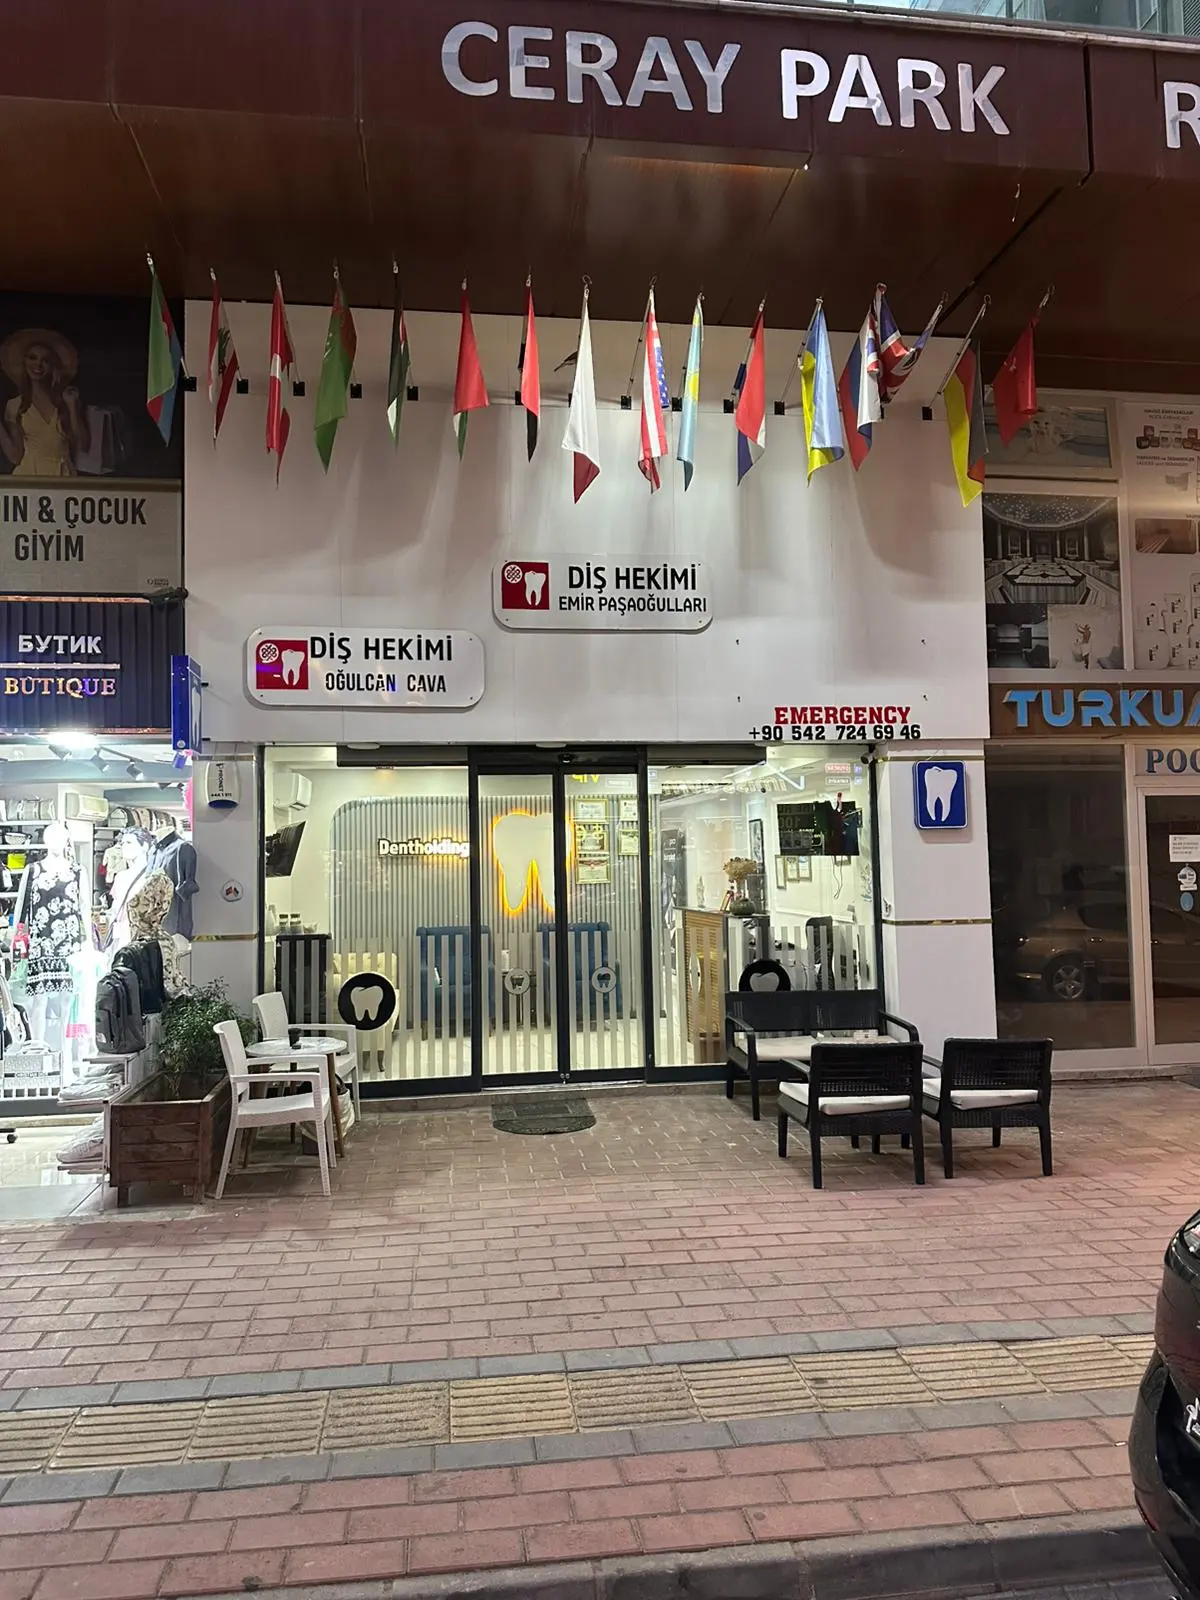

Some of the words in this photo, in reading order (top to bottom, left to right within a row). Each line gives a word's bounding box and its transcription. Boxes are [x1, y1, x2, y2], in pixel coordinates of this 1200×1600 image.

[441, 21, 741, 113] CERAY
[780, 48, 1010, 135] PARK
[38, 496, 56, 523] &
[65, 496, 147, 529] ÇOCUK
[14, 528, 84, 562] GİYİM
[568, 562, 607, 593] DİŞ
[615, 563, 696, 591] HEKİMİ
[558, 592, 595, 611] EMİR
[599, 593, 707, 616] PAŞAOĞULLARI
[18, 634, 102, 654] БУТИК
[310, 632, 352, 664] DİŞ
[364, 635, 452, 661] HEKİMİ
[4, 676, 116, 698] BUTIQUE
[325, 669, 396, 692] OĞULCAN
[407, 674, 447, 692] CAVA
[774, 706, 911, 725] EMERGENCY
[749, 725, 783, 740] +90
[791, 725, 826, 740] 542
[836, 725, 867, 740] 724
[873, 725, 894, 740] 69
[900, 724, 921, 740] 46
[378, 837, 470, 859] Dentholding
